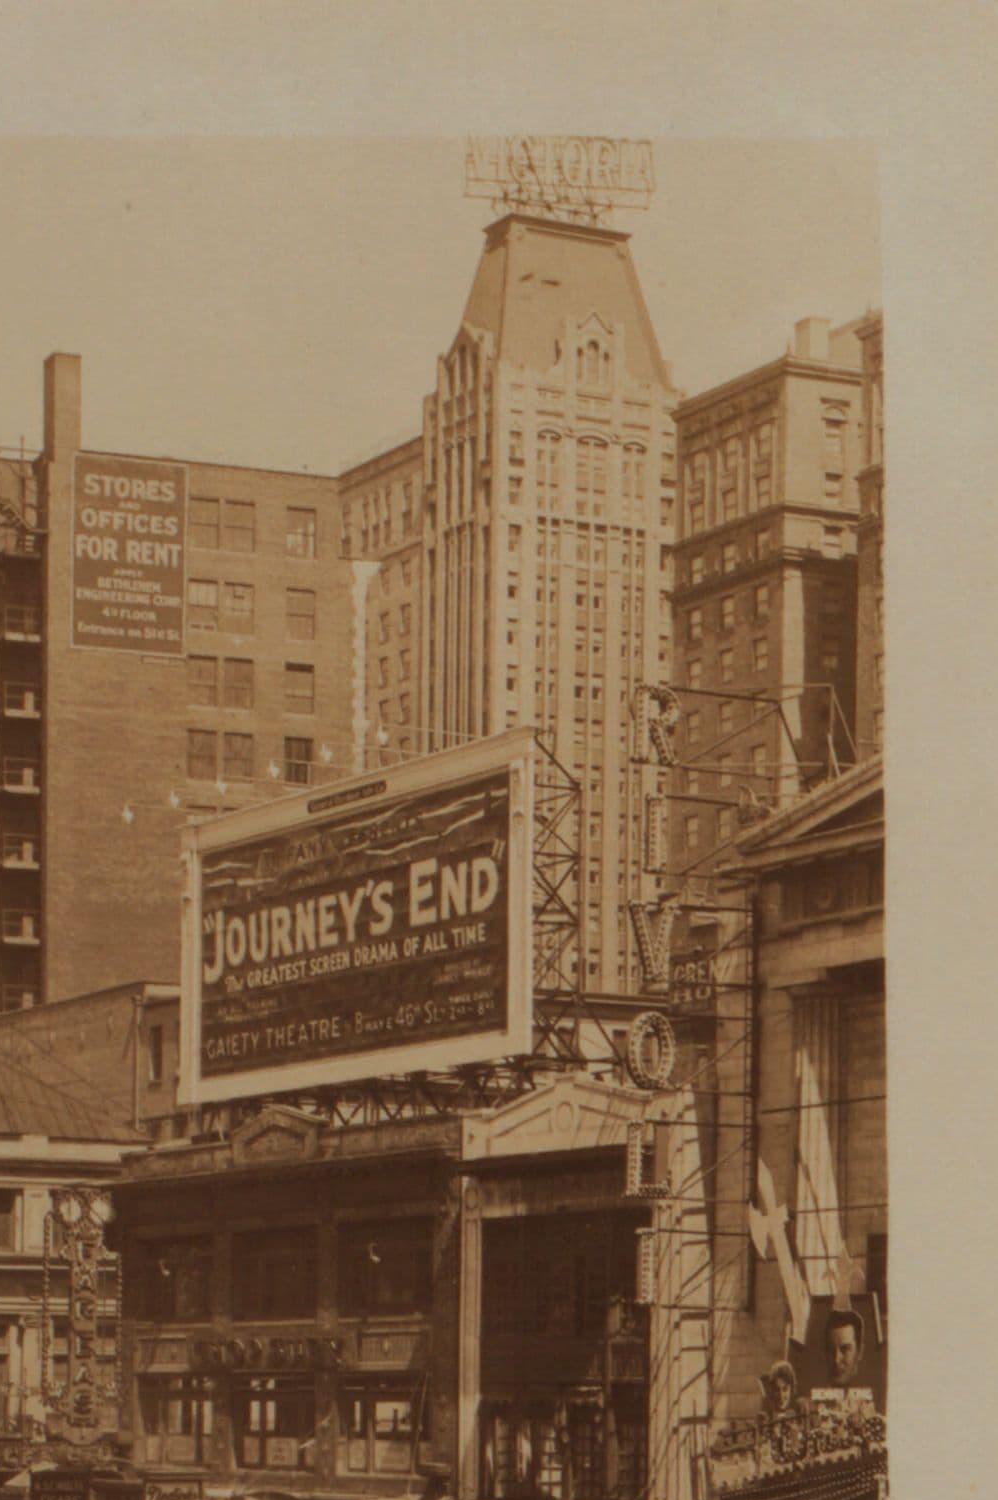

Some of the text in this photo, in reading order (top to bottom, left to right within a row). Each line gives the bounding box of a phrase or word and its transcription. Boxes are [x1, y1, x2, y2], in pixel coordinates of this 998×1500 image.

[83, 473, 176, 502] STORES
[81, 507, 178, 536] OFFICES
[75, 534, 182, 568] FOR RENT
[246, 960, 307, 990] GREATEST
[309, 953, 351, 977] SCREEN
[353, 941, 399, 967] DRAMA
[403, 936, 420, 958] OF
[422, 929, 449, 955] ALL
[452, 921, 487, 949] TIME
[205, 1028, 260, 1061] GAIETY
[265, 1014, 341, 1048] THEATRE
